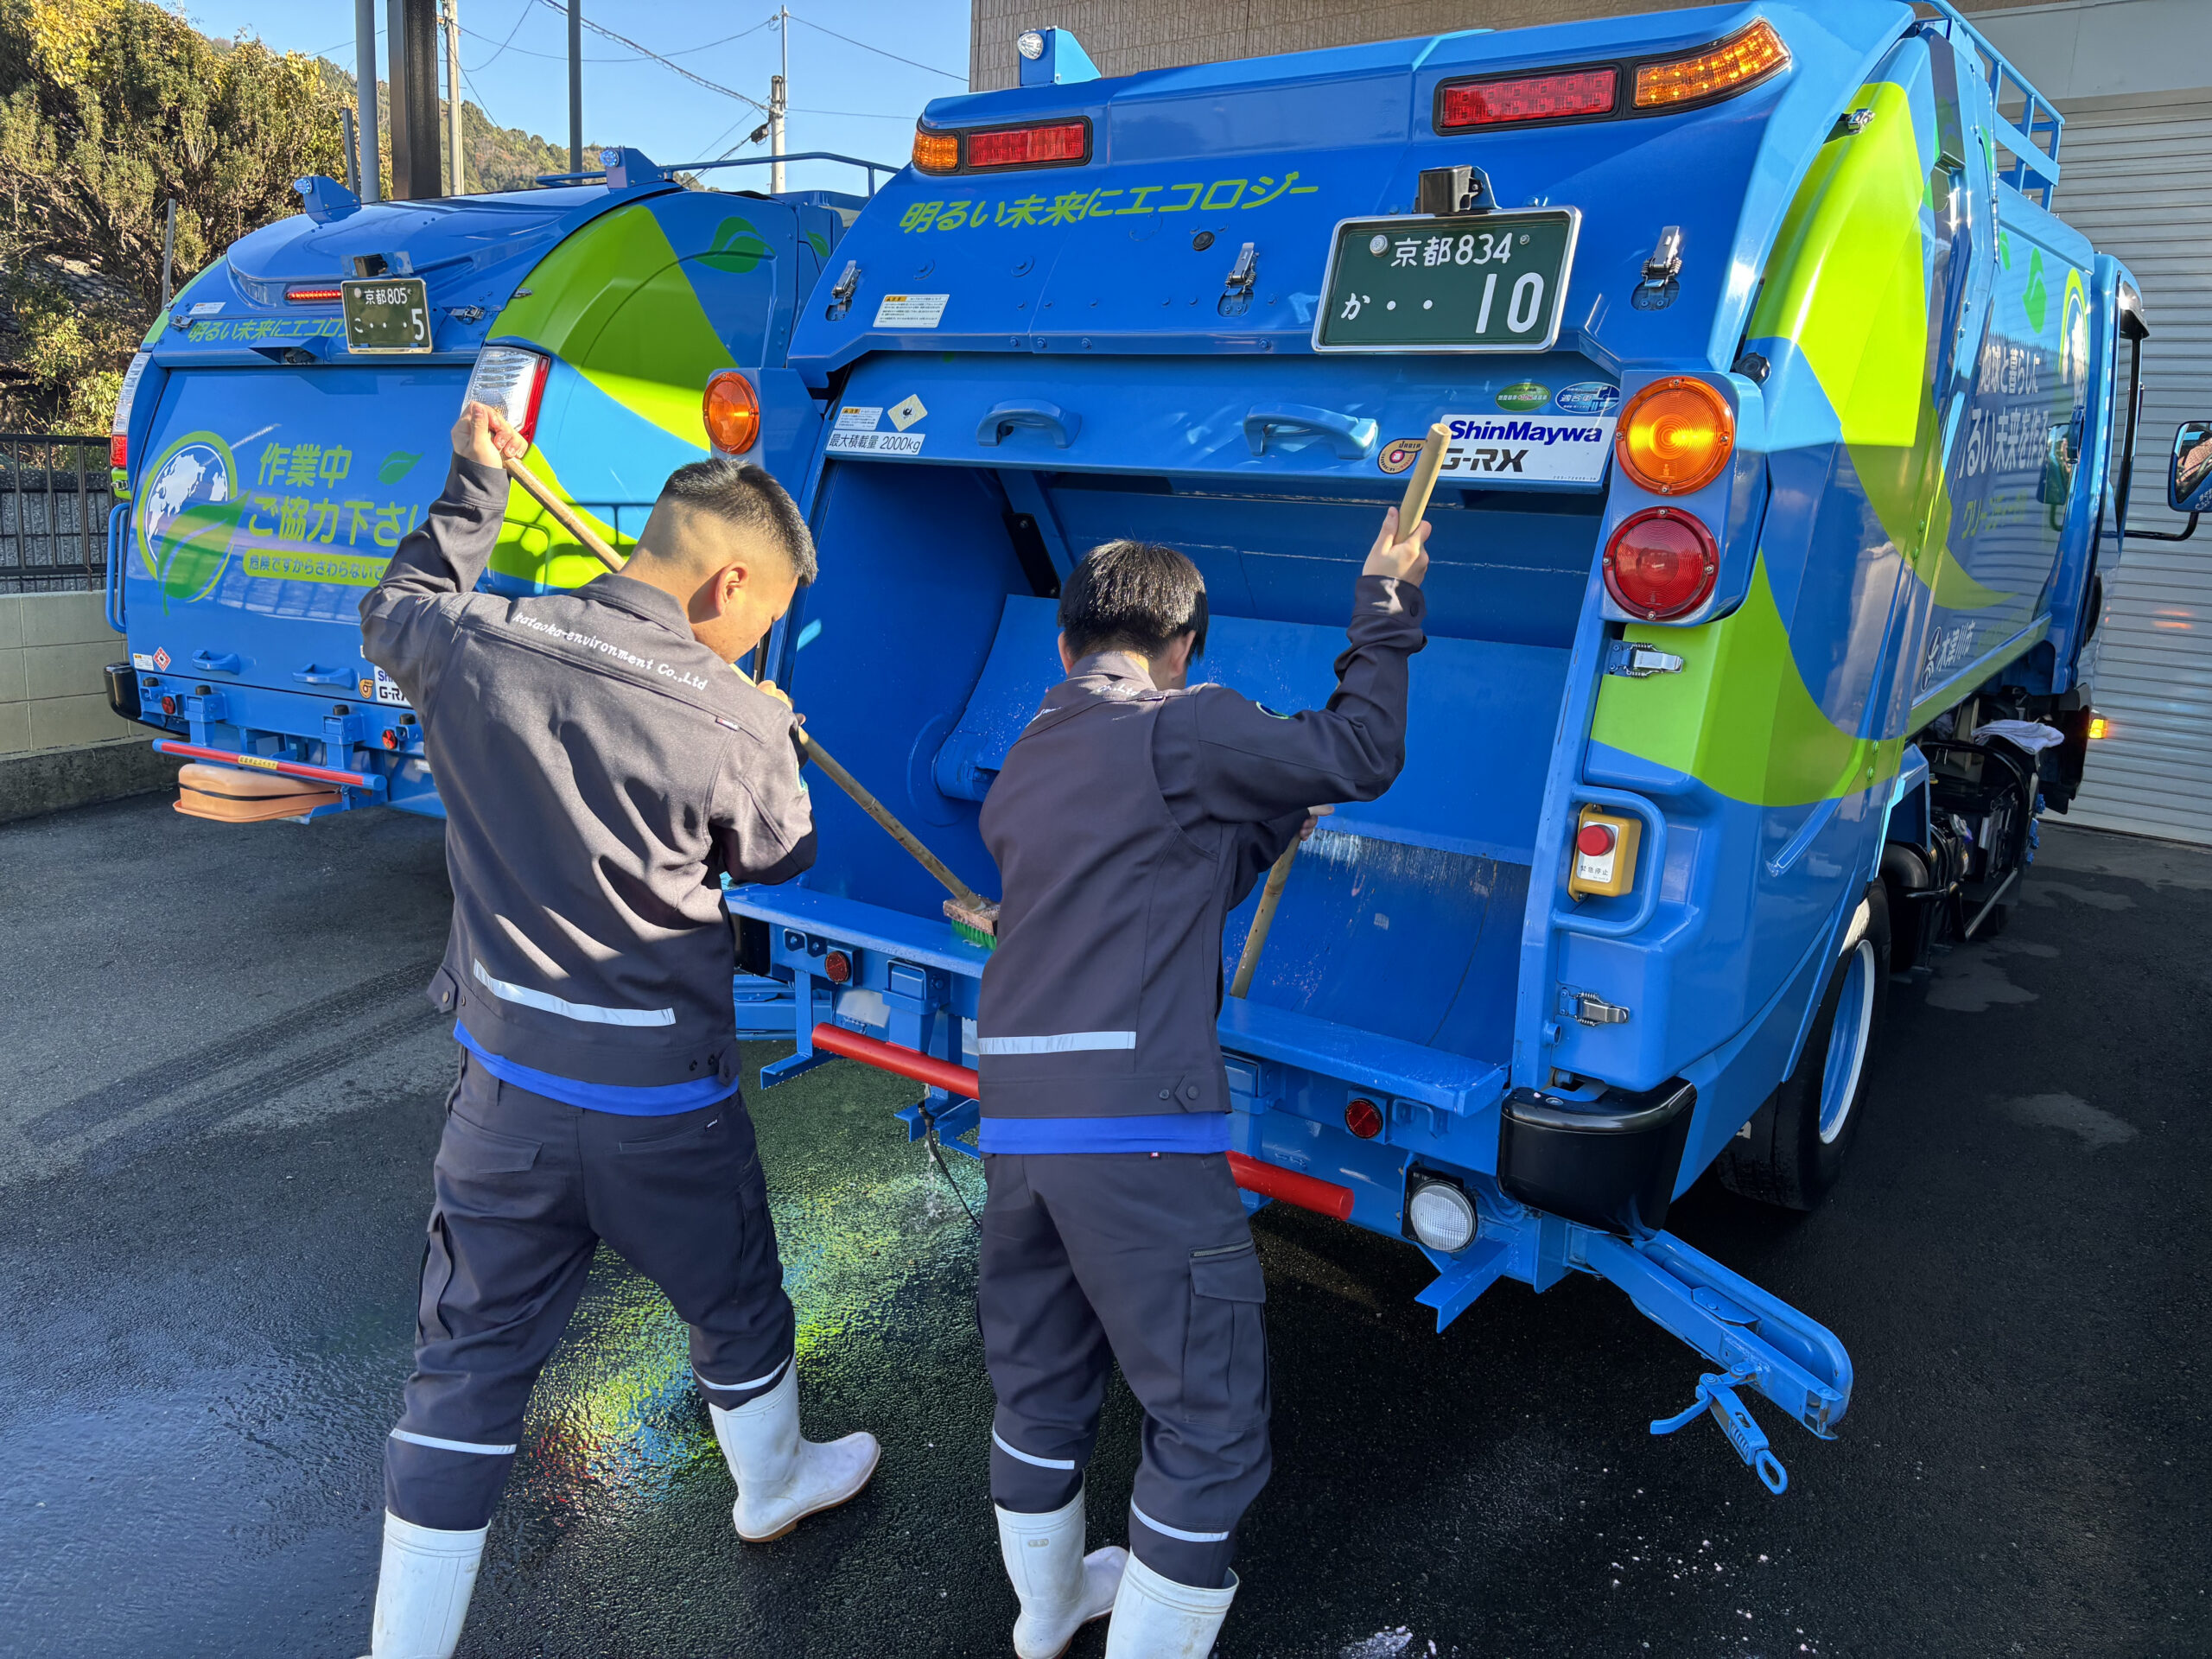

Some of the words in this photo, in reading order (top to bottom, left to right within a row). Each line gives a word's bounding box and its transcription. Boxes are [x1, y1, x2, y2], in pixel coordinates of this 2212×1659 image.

[899, 171, 1319, 234] 明るい未来にエコロジー
[1390, 232, 1513, 267] 京都834
[364, 287, 407, 305] 京都805
[1340, 292, 1370, 321] か
[1475, 271, 1545, 334] 10
[411, 308, 425, 340] 5
[829, 433, 879, 449] 最大積載量
[880, 435, 921, 454] 2000kg
[1449, 420, 1603, 446] ShinMaywa
[1959, 406, 2050, 479] るい未来を作る
[257, 442, 353, 490] 作業中
[1440, 448, 1529, 474] G-RX
[512, 612, 654, 671] kataoka-environment
